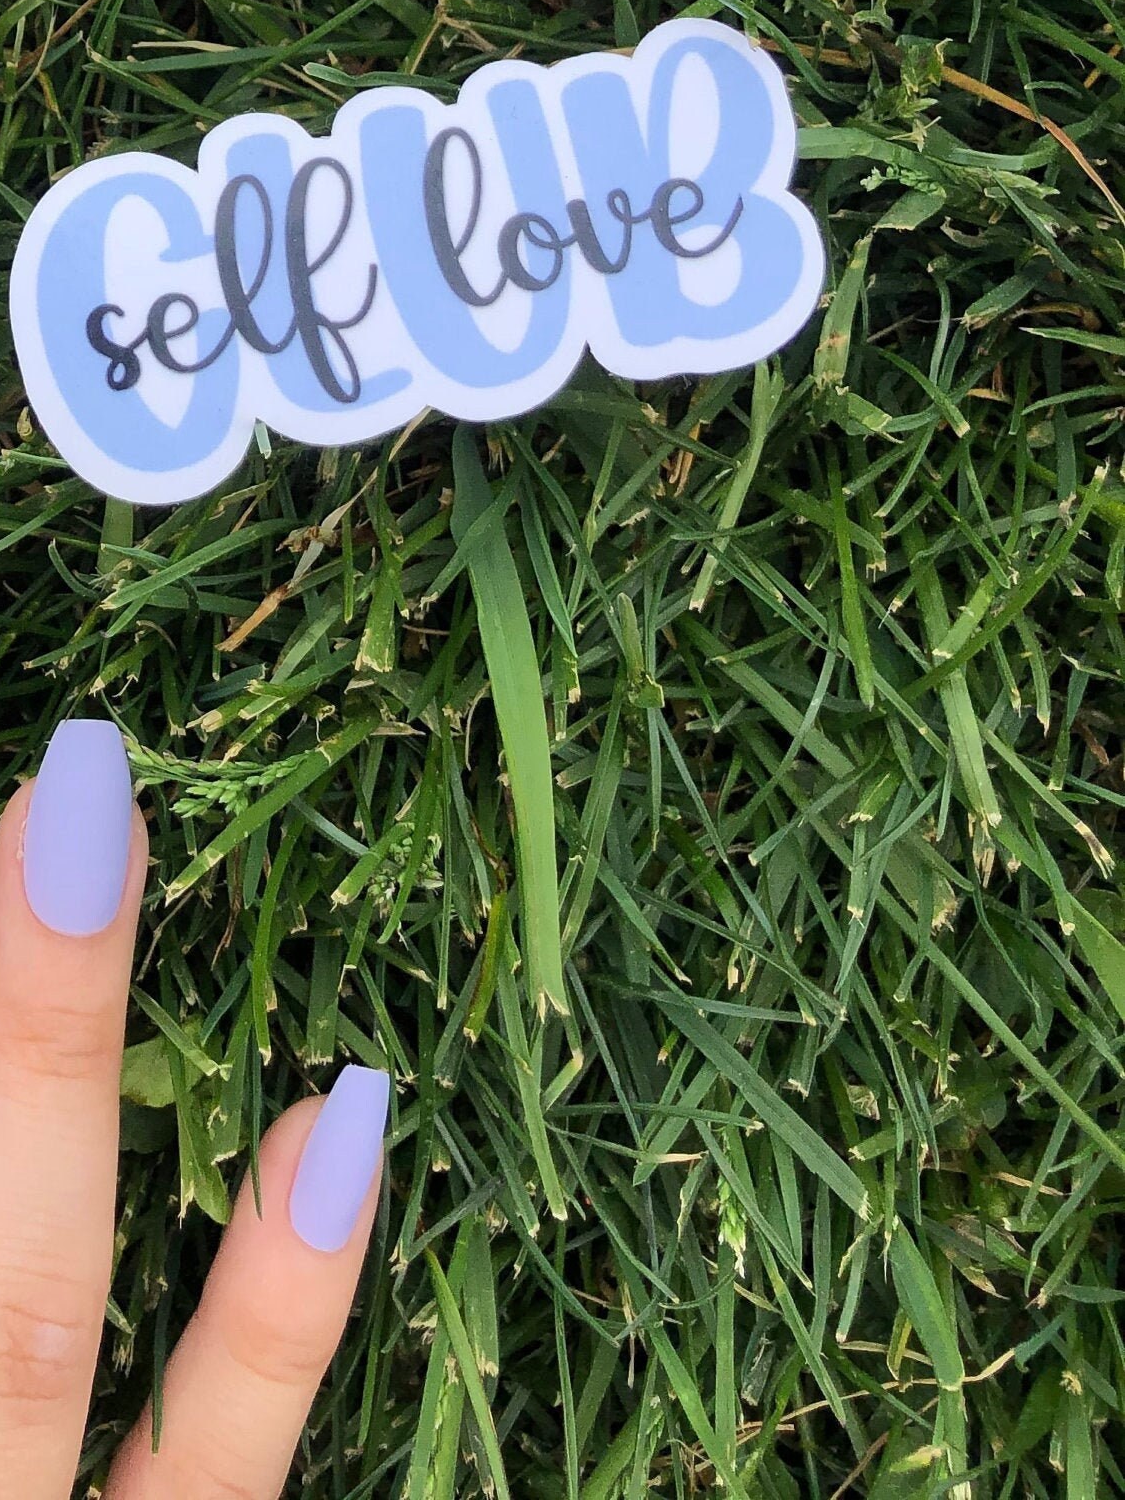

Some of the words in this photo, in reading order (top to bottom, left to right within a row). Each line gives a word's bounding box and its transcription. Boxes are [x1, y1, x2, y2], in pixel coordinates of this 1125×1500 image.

[36, 36, 804, 473] CLUB
[85, 156, 378, 403] self
[423, 126, 744, 307] love
